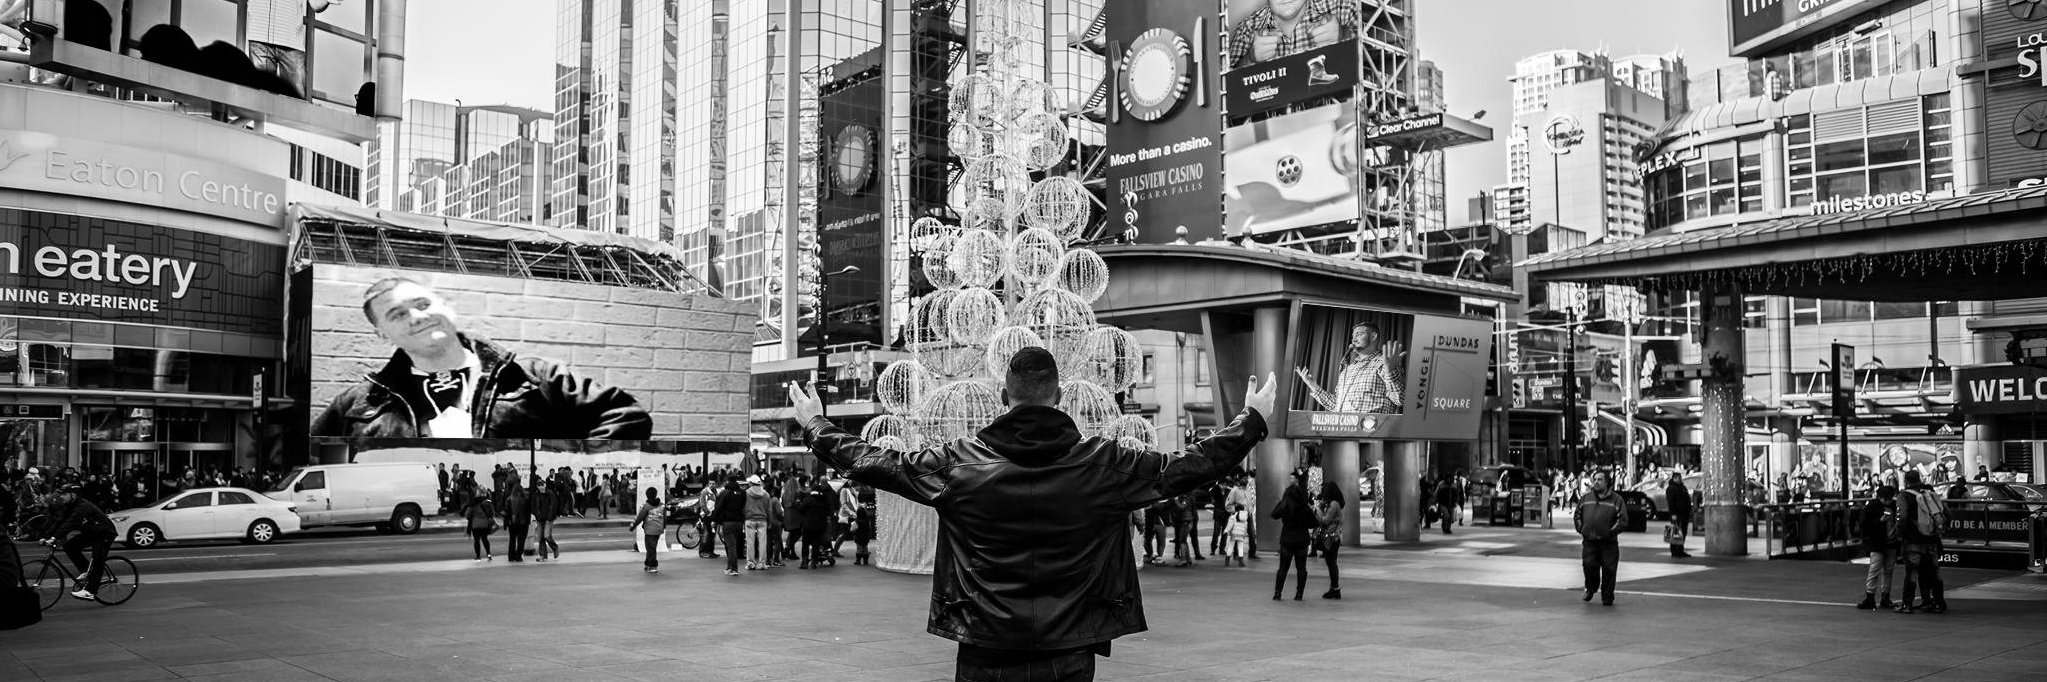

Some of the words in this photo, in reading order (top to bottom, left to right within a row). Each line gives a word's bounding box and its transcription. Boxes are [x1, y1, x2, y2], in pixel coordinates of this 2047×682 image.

[1242, 70, 1276, 86] TIVOLI
[1278, 67, 1287, 77] II
[1379, 123, 1402, 135] Clear
[1403, 114, 1440, 130] Channel
[1110, 153, 1136, 167] More
[1138, 147, 1161, 161] than
[1163, 145, 1171, 155] a
[1173, 136, 1212, 153] casino.
[45, 148, 164, 193] Eaton
[178, 170, 278, 215] Centre
[1120, 170, 1166, 194] FALLSVIEW
[1168, 162, 1203, 185] CASINO
[1120, 192, 1167, 204] NGARA
[1172, 182, 1203, 195] FALLS
[1810, 189, 1923, 216] milestones
[34, 244, 197, 299] eatery
[58, 292, 159, 312] EXPERIENCE
[1438, 335, 1479, 349] DUNDAS
[1416, 356, 1430, 409] YONGE
[1433, 397, 1471, 409] SQUARE
[1963, 520, 1975, 529] BE
[1978, 520, 1985, 529] A
[1989, 521, 2029, 531] MEMBER
